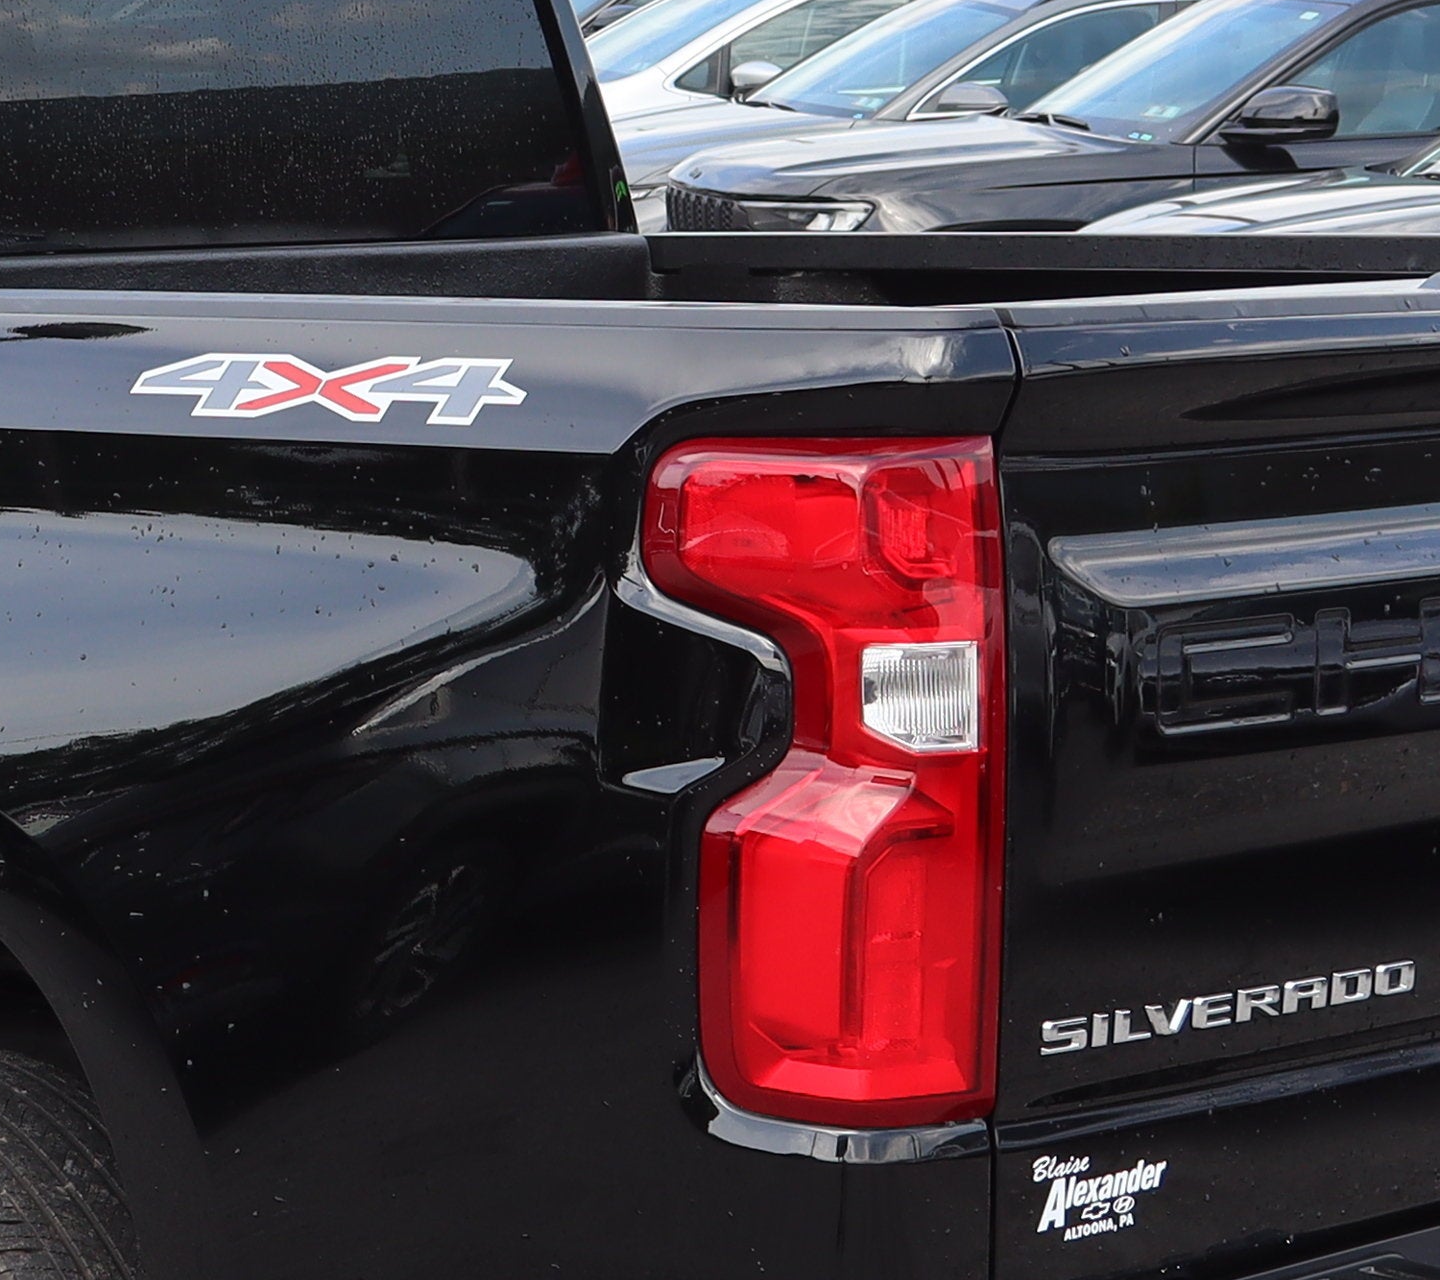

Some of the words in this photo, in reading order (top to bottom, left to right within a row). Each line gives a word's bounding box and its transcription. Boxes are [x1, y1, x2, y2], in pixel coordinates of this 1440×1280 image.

[1039, 959, 1416, 1056] SILVERADO
[1032, 1155, 1090, 1182] Blaise
[1037, 1159, 1167, 1233] Alexander
[1063, 1217, 1118, 1241] ALTOONA,
[1119, 1213, 1135, 1228] PA
